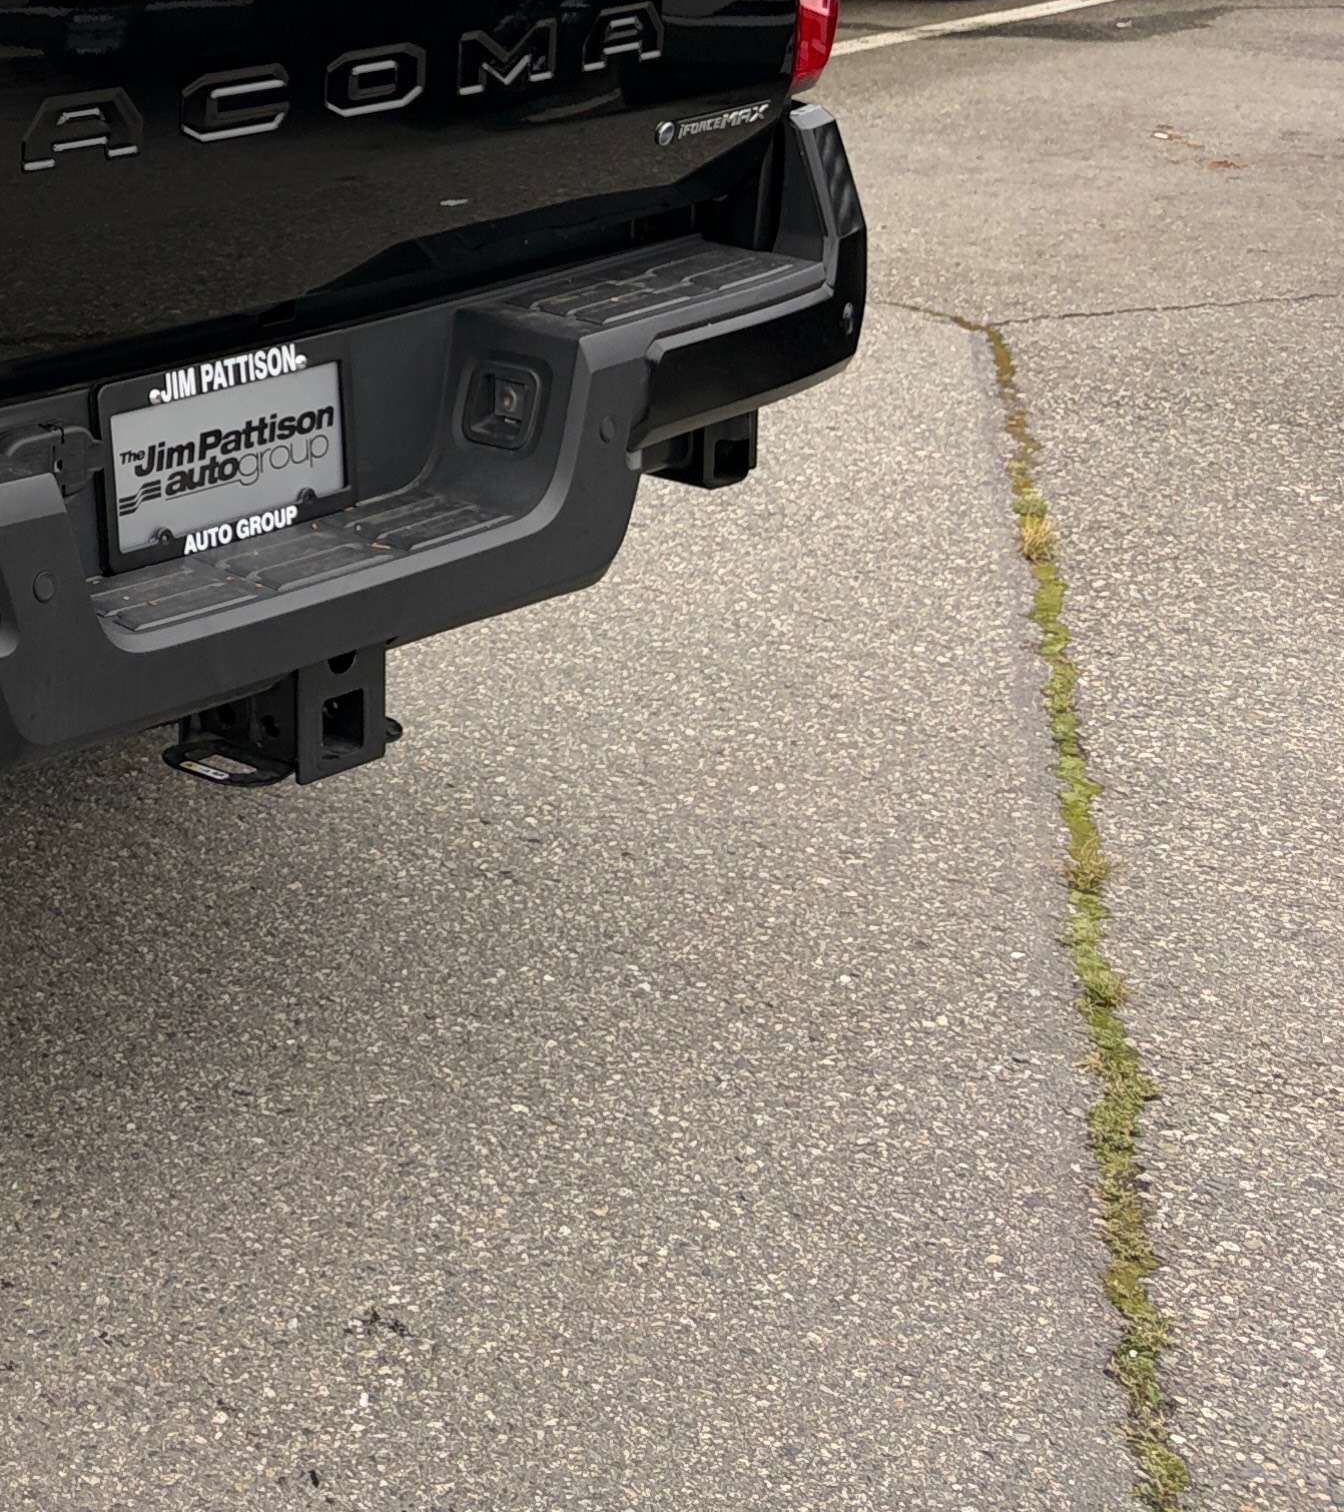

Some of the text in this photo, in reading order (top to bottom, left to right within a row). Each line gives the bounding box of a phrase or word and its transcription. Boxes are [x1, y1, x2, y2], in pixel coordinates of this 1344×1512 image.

[161, 343, 297, 403] JIM PATTISON
[120, 405, 335, 478] The Jim Pattison
[183, 505, 299, 556] AUTO GROUP
